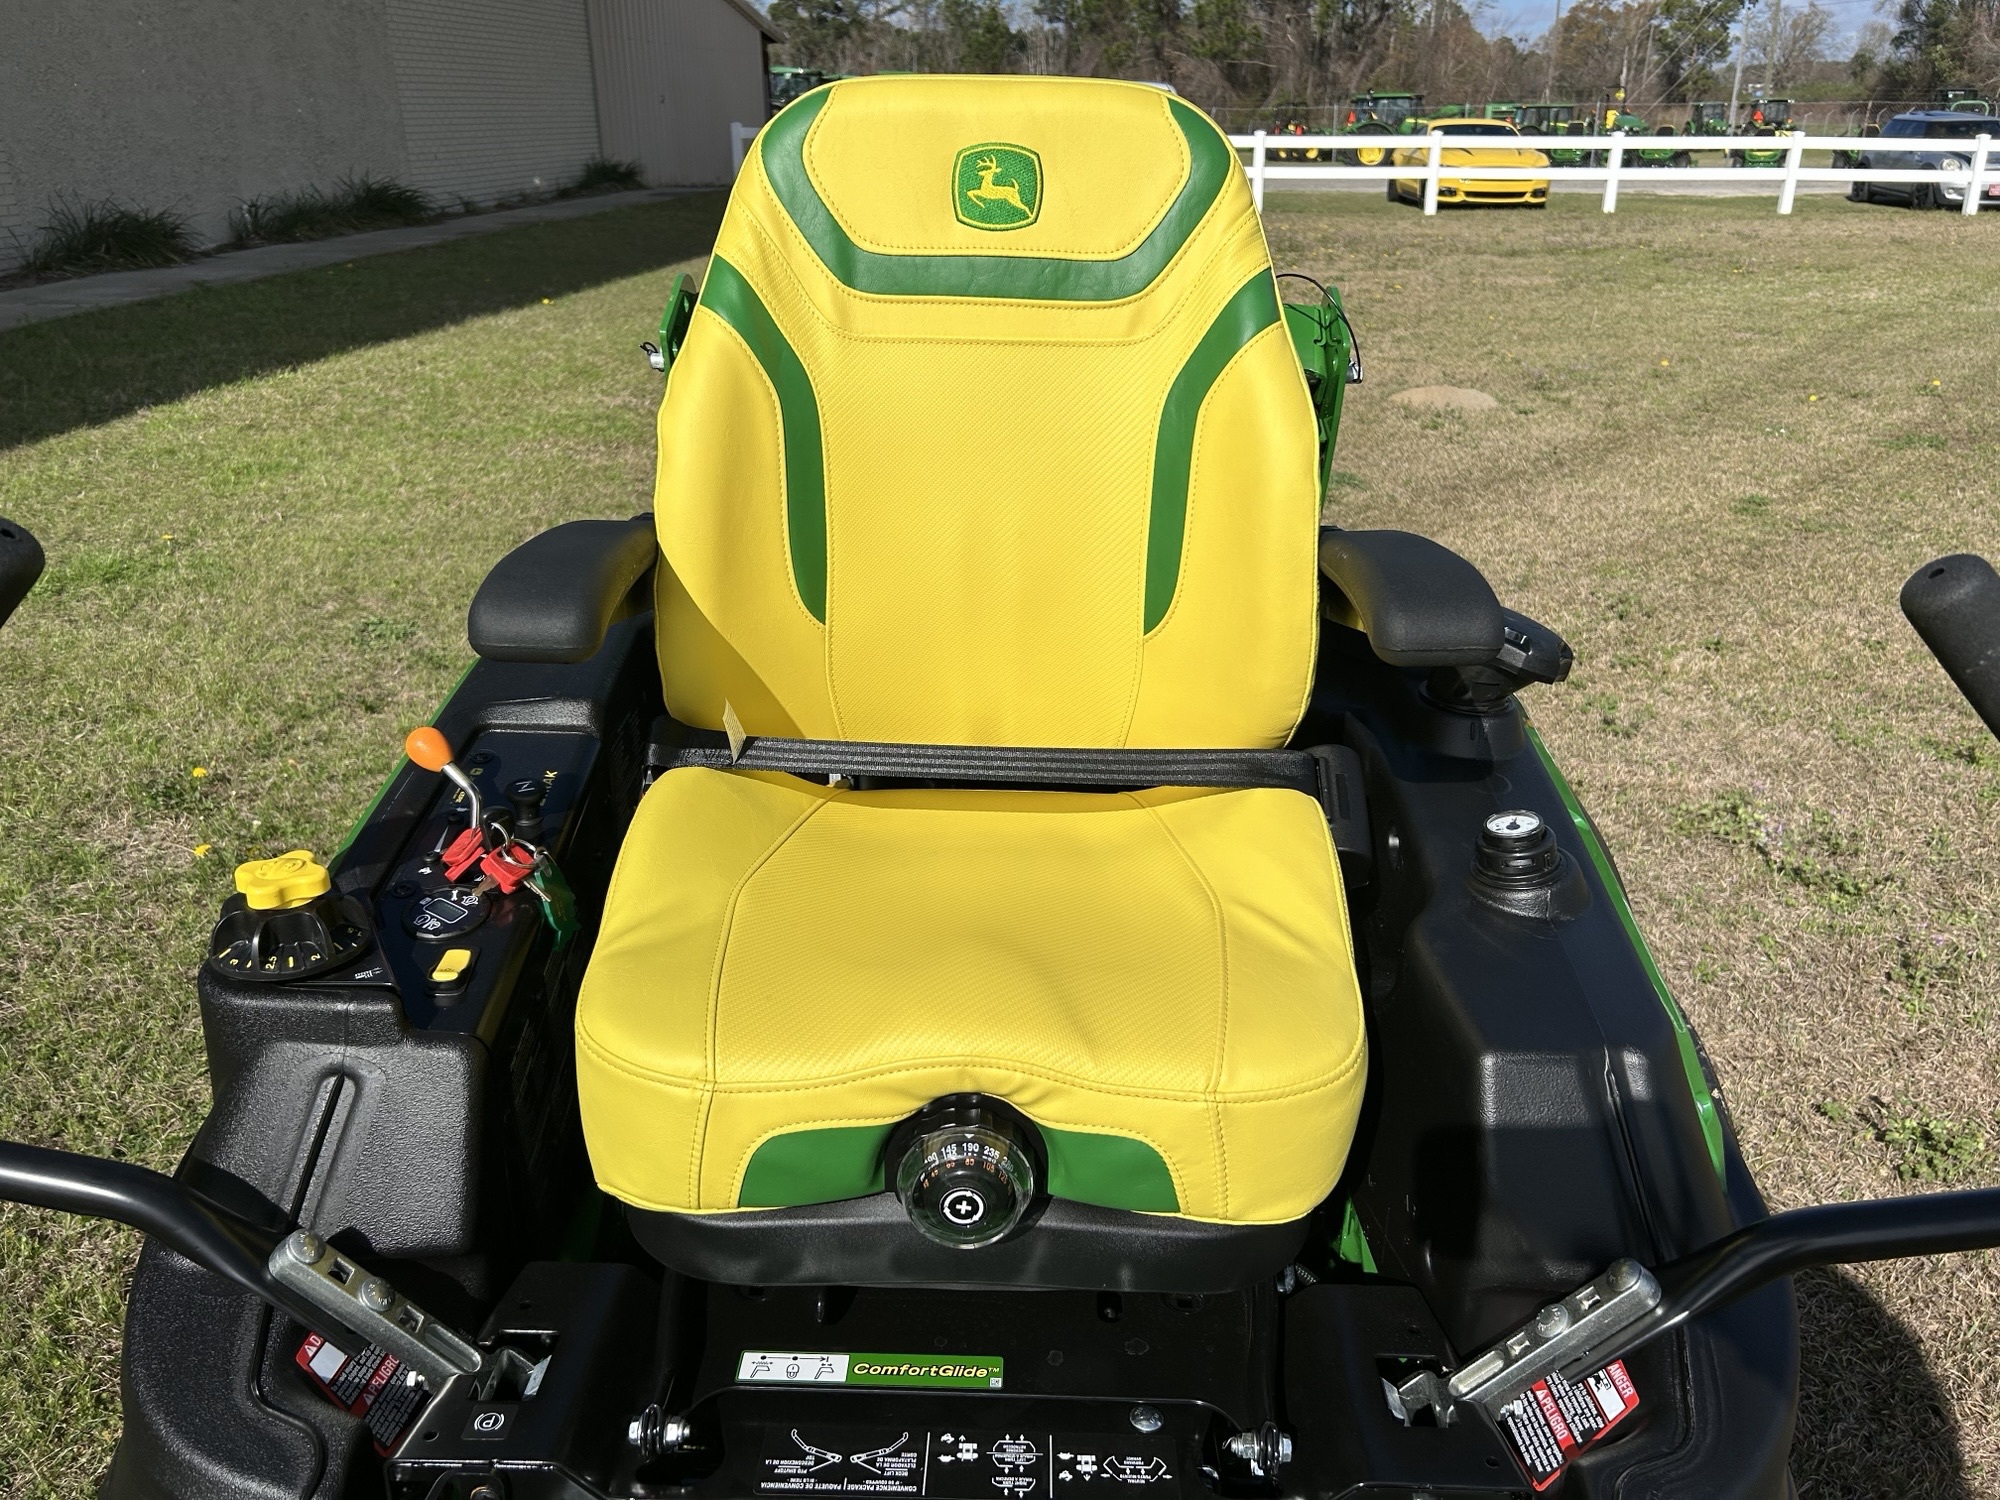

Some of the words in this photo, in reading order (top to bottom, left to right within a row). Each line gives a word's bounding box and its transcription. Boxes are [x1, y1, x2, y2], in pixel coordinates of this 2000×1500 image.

[265, 955, 278, 970] 2.5
[962, 1143, 979, 1152] 190
[984, 1145, 1000, 1160] 235
[1607, 1361, 1635, 1398] ANGER
[1537, 1396, 1570, 1440] PELIGRO
[760, 1481, 804, 1489] CONVENIENCIA
[814, 1482, 841, 1490] PAQUETE
[875, 1484, 916, 1492] CONVENIENCE
